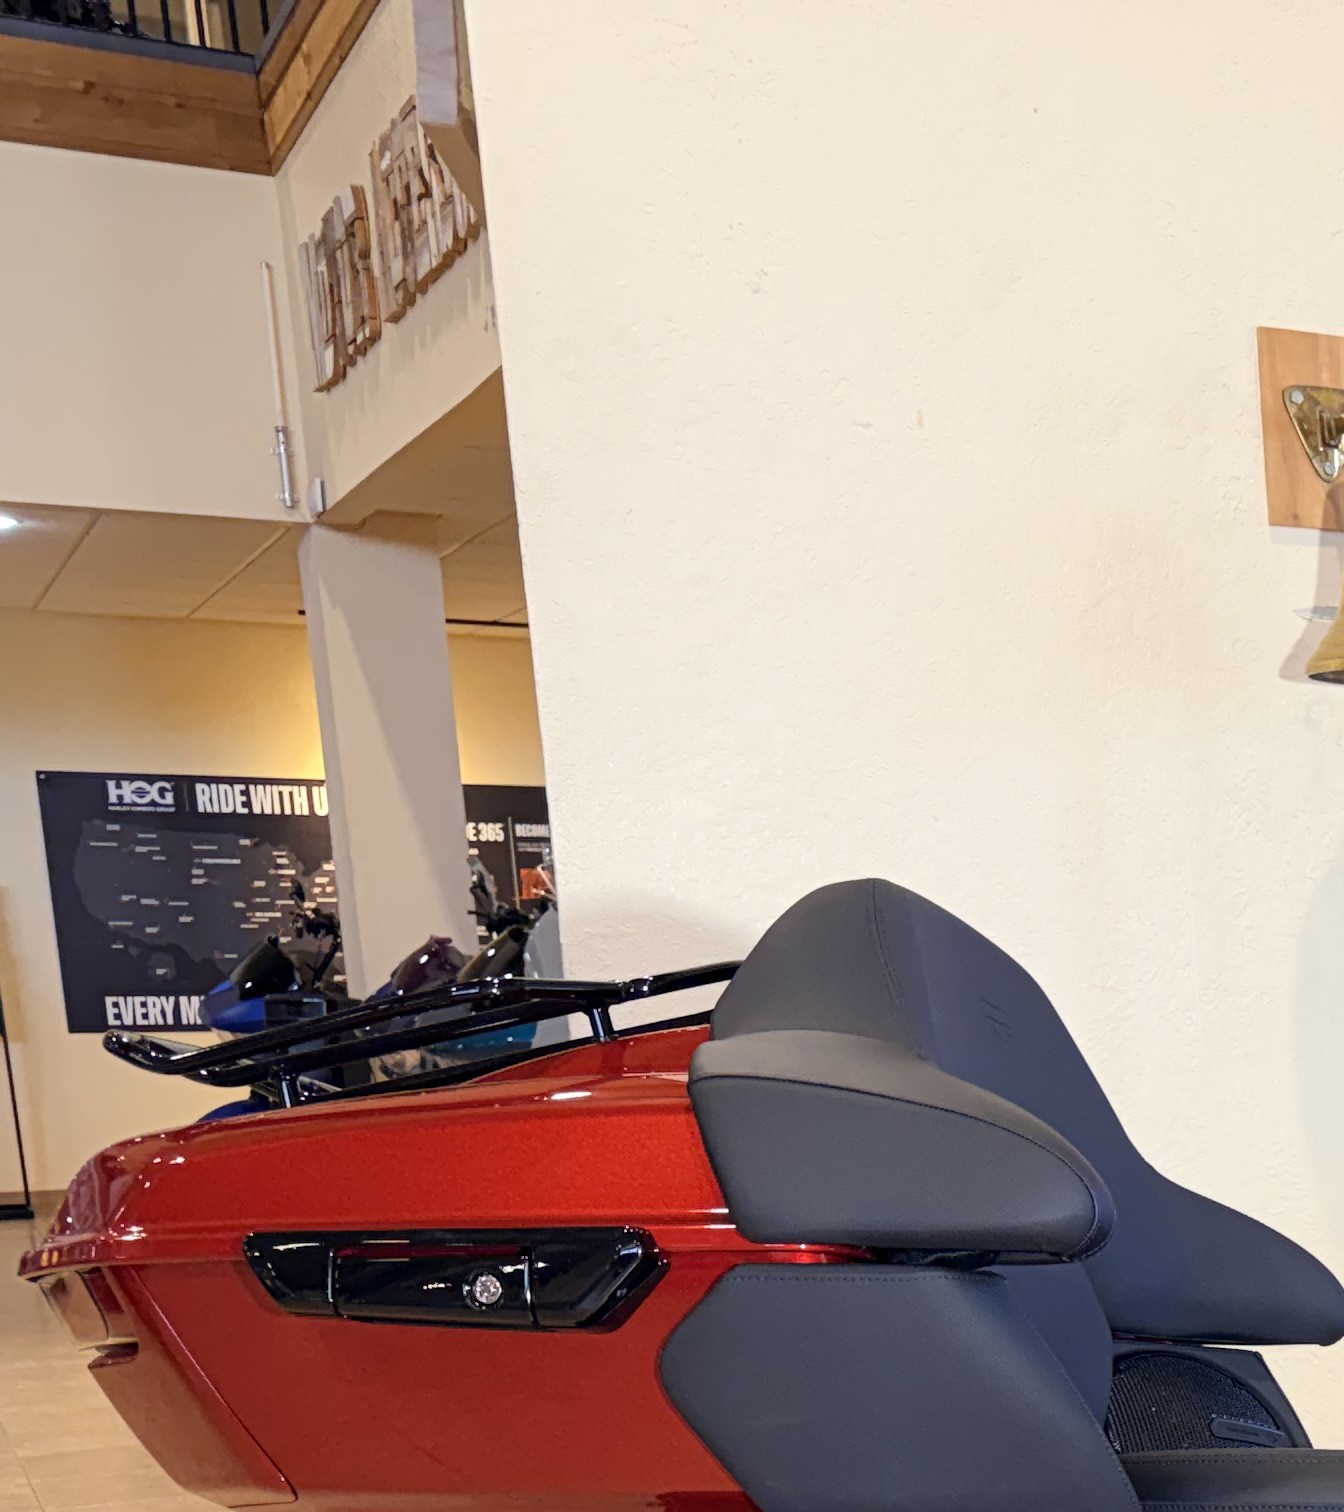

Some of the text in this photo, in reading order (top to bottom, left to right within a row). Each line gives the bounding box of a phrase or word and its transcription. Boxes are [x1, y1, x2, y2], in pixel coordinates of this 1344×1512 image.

[105, 779, 175, 805] HOG
[194, 783, 328, 817] RIDE WITH U
[477, 822, 505, 843] 365
[104, 995, 175, 1027] EVERY
